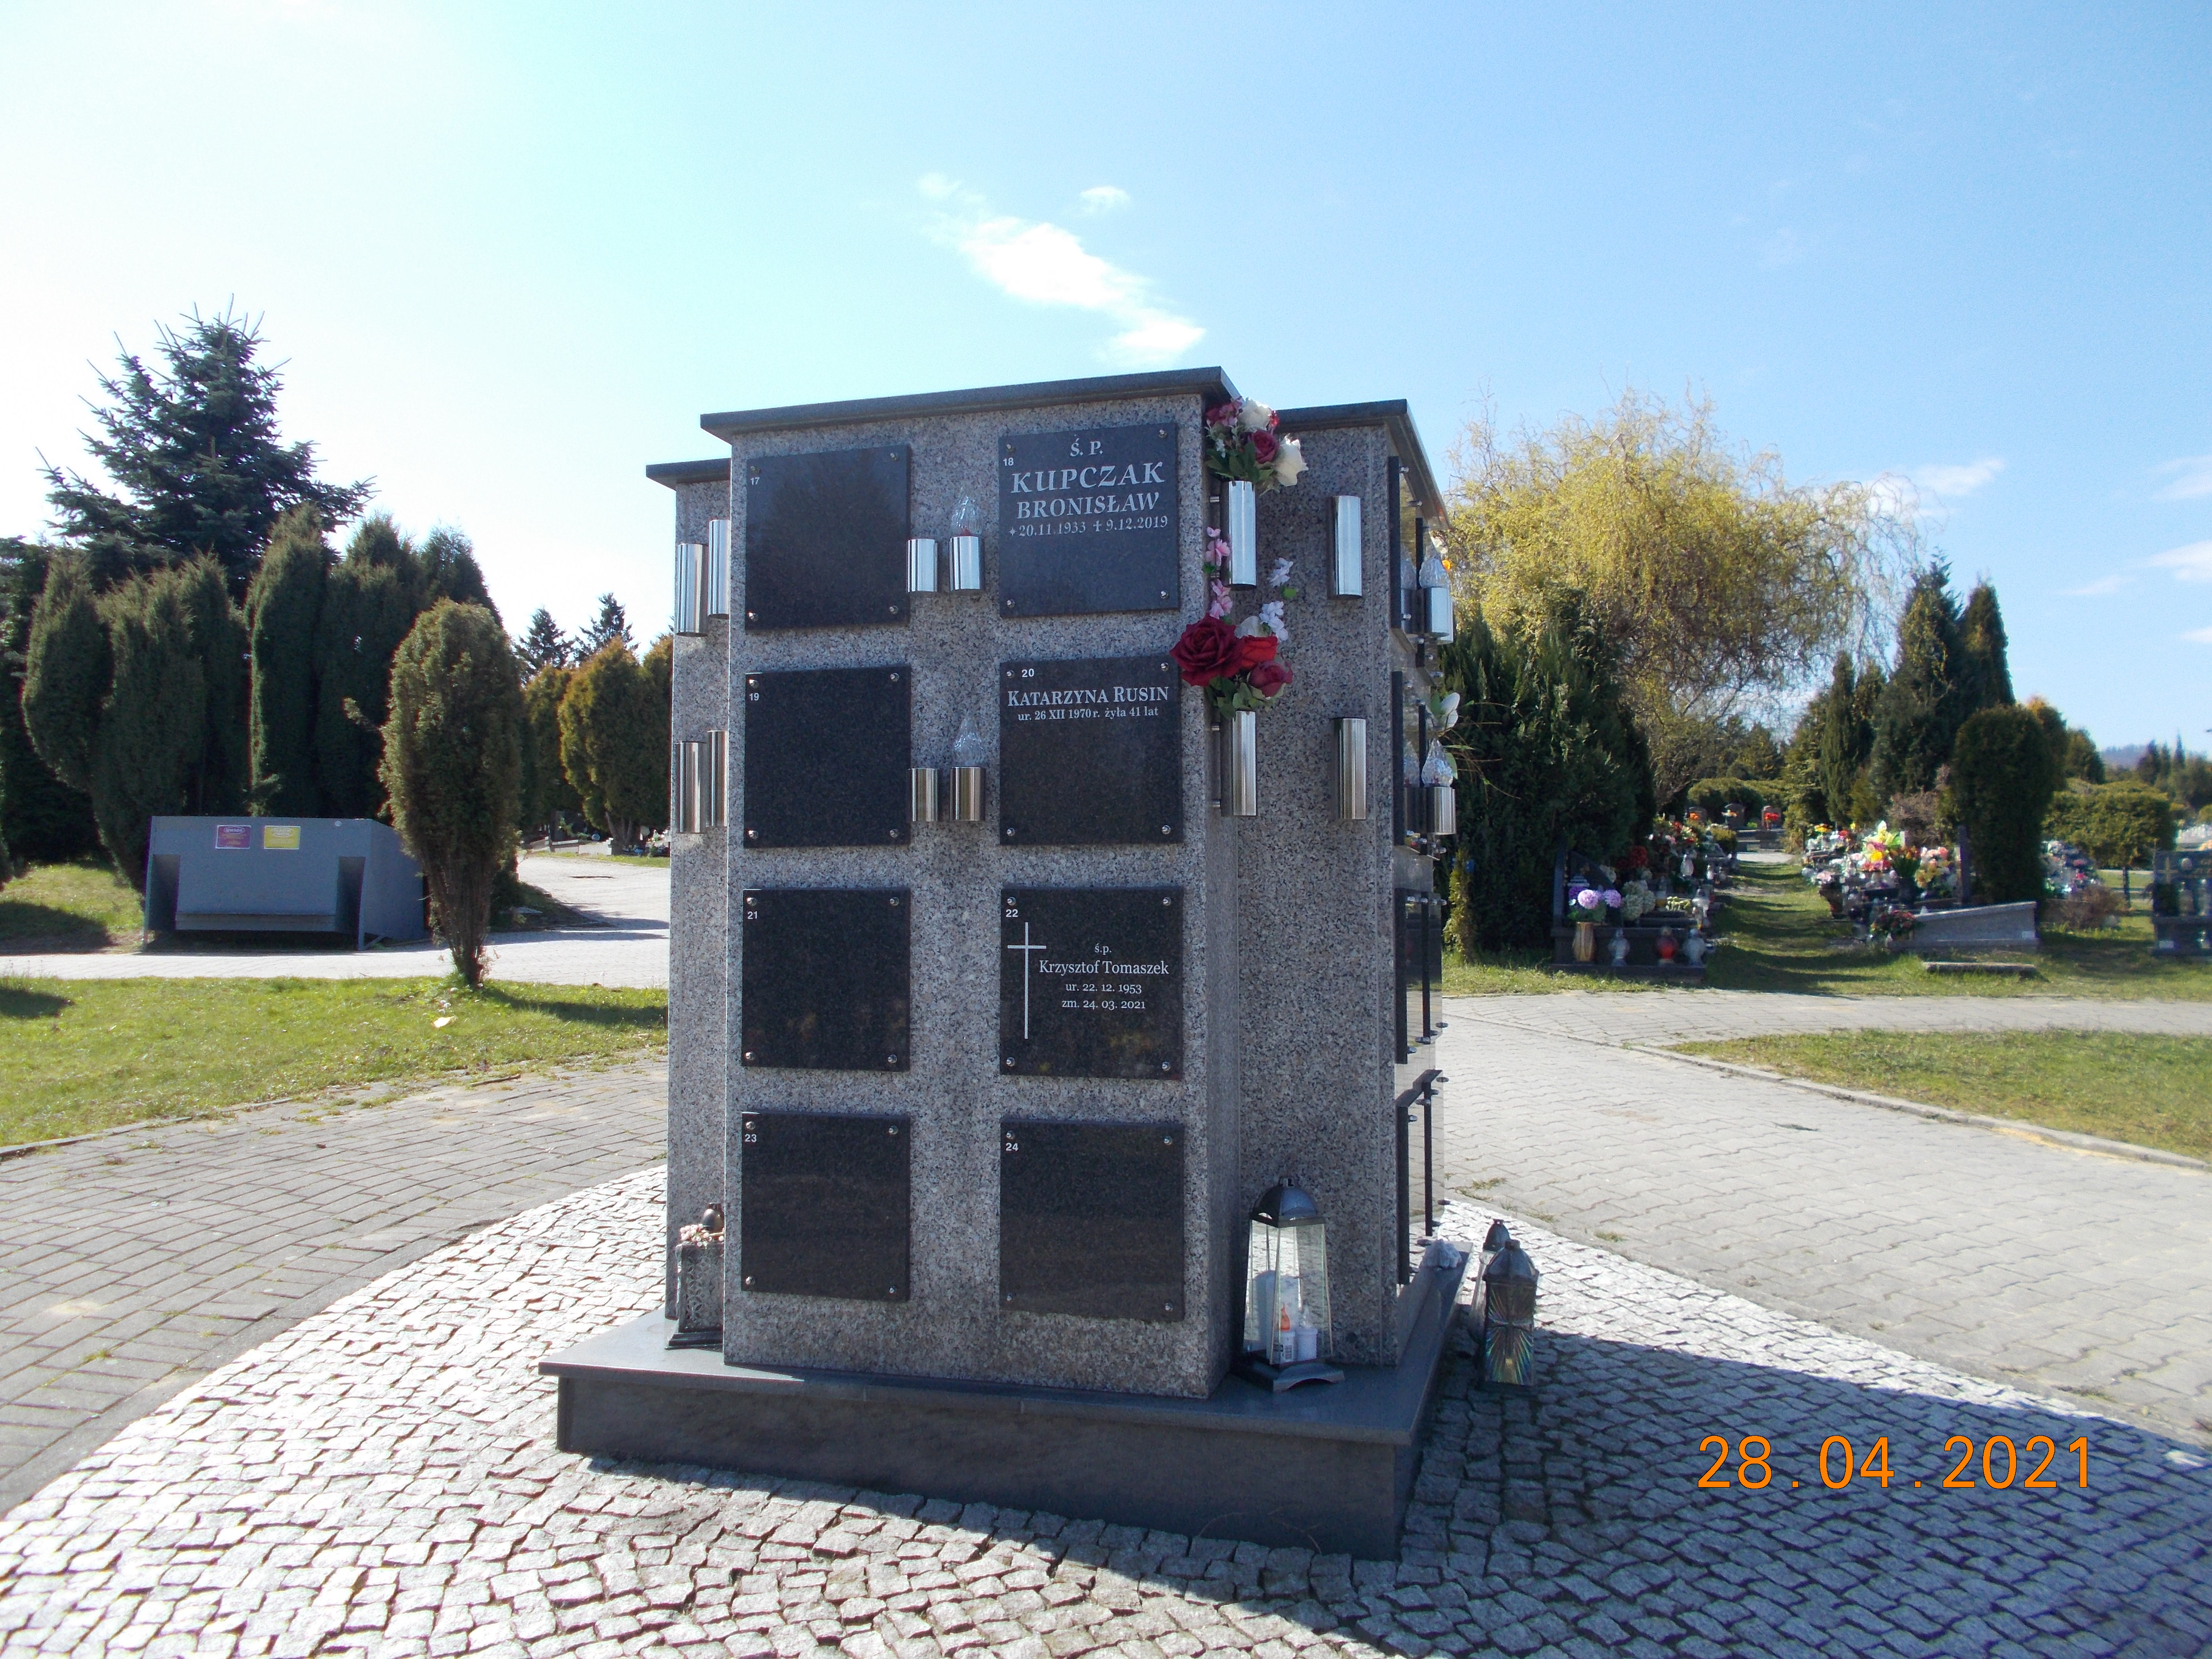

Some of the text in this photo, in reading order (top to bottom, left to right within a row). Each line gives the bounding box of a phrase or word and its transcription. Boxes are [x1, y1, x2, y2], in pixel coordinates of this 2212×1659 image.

[1003, 457, 1014, 466] 18
[750, 477, 760, 485] 17
[1011, 461, 1165, 493] KUPCZAK
[1016, 492, 1159, 519] BRONISŁAW
[1022, 668, 1034, 678] 20
[749, 692, 759, 701] 19
[1008, 686, 1169, 707] KATARZYNA RUSIN
[1034, 710, 1046, 720] 26
[1048, 709, 1065, 720] XII
[1105, 707, 1126, 720] żyła
[1129, 707, 1141, 717] 41
[1144, 706, 1158, 716] lat
[747, 911, 757, 919] 21
[1006, 909, 1018, 917] 22
[1094, 943, 1112, 955] ś.p.
[1039, 960, 1169, 976] Krzysztof Tomaszek
[1101, 984, 1115, 992] 12.
[1118, 984, 1142, 994] 1953
[1083, 1000, 1098, 1010] 24.
[1101, 1000, 1118, 1010] 03.
[1121, 1001, 1145, 1009] 2021
[745, 1133, 757, 1142] 23
[1006, 1142, 1019, 1151] 24
